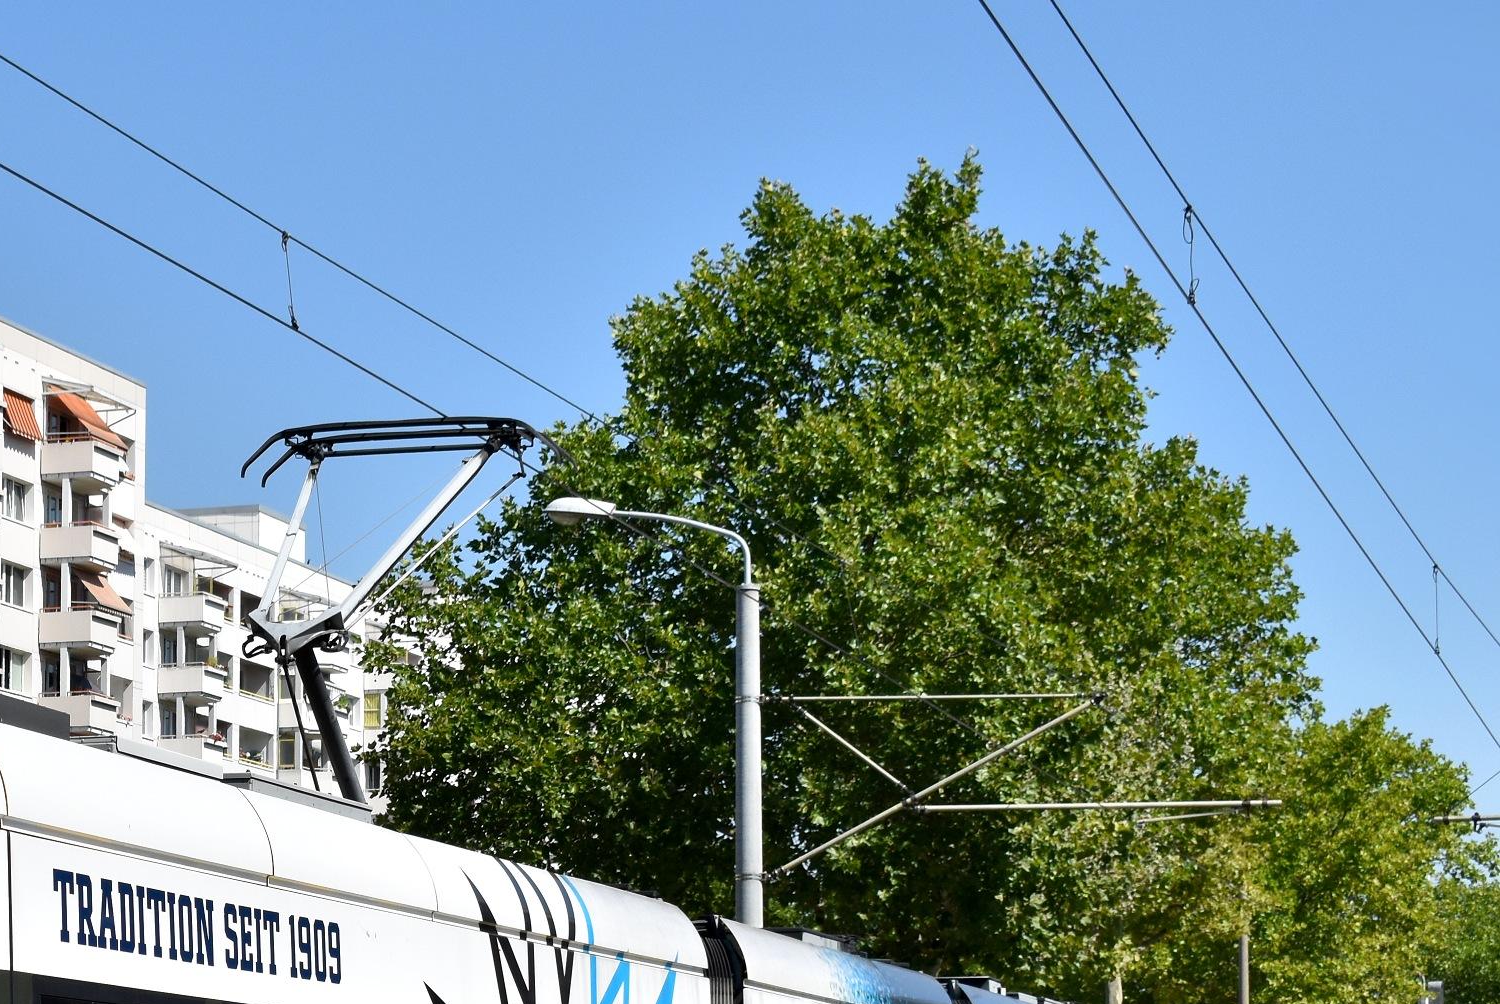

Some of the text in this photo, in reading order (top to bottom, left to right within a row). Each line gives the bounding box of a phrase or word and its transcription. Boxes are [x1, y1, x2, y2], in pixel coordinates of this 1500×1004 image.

[53, 868, 342, 984] TRADITION SEIT 1909
